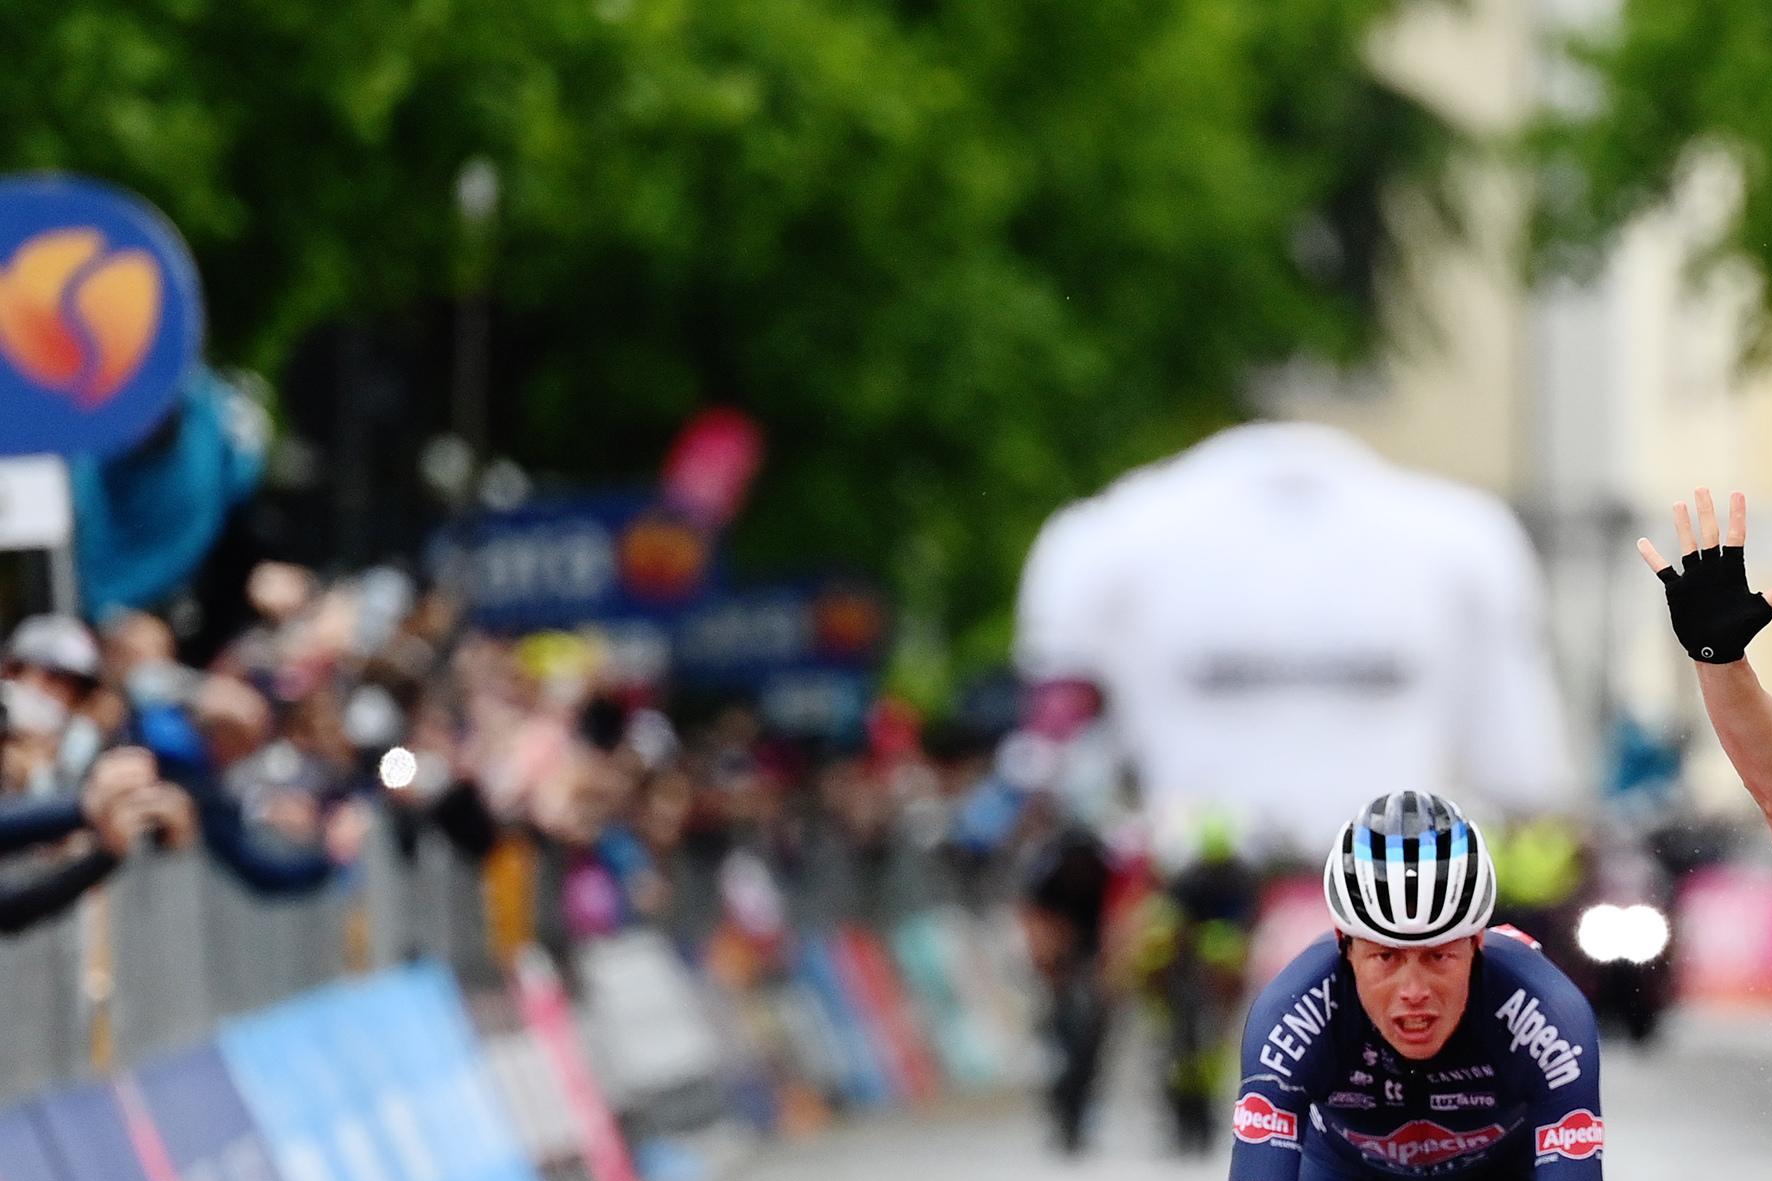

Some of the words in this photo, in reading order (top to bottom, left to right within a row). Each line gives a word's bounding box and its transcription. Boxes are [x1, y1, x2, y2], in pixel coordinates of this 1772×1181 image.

[1259, 977, 1338, 1077] FENIX
[1495, 988, 1582, 1090] Alpecin
[1358, 1134, 1492, 1166] Alpecin
